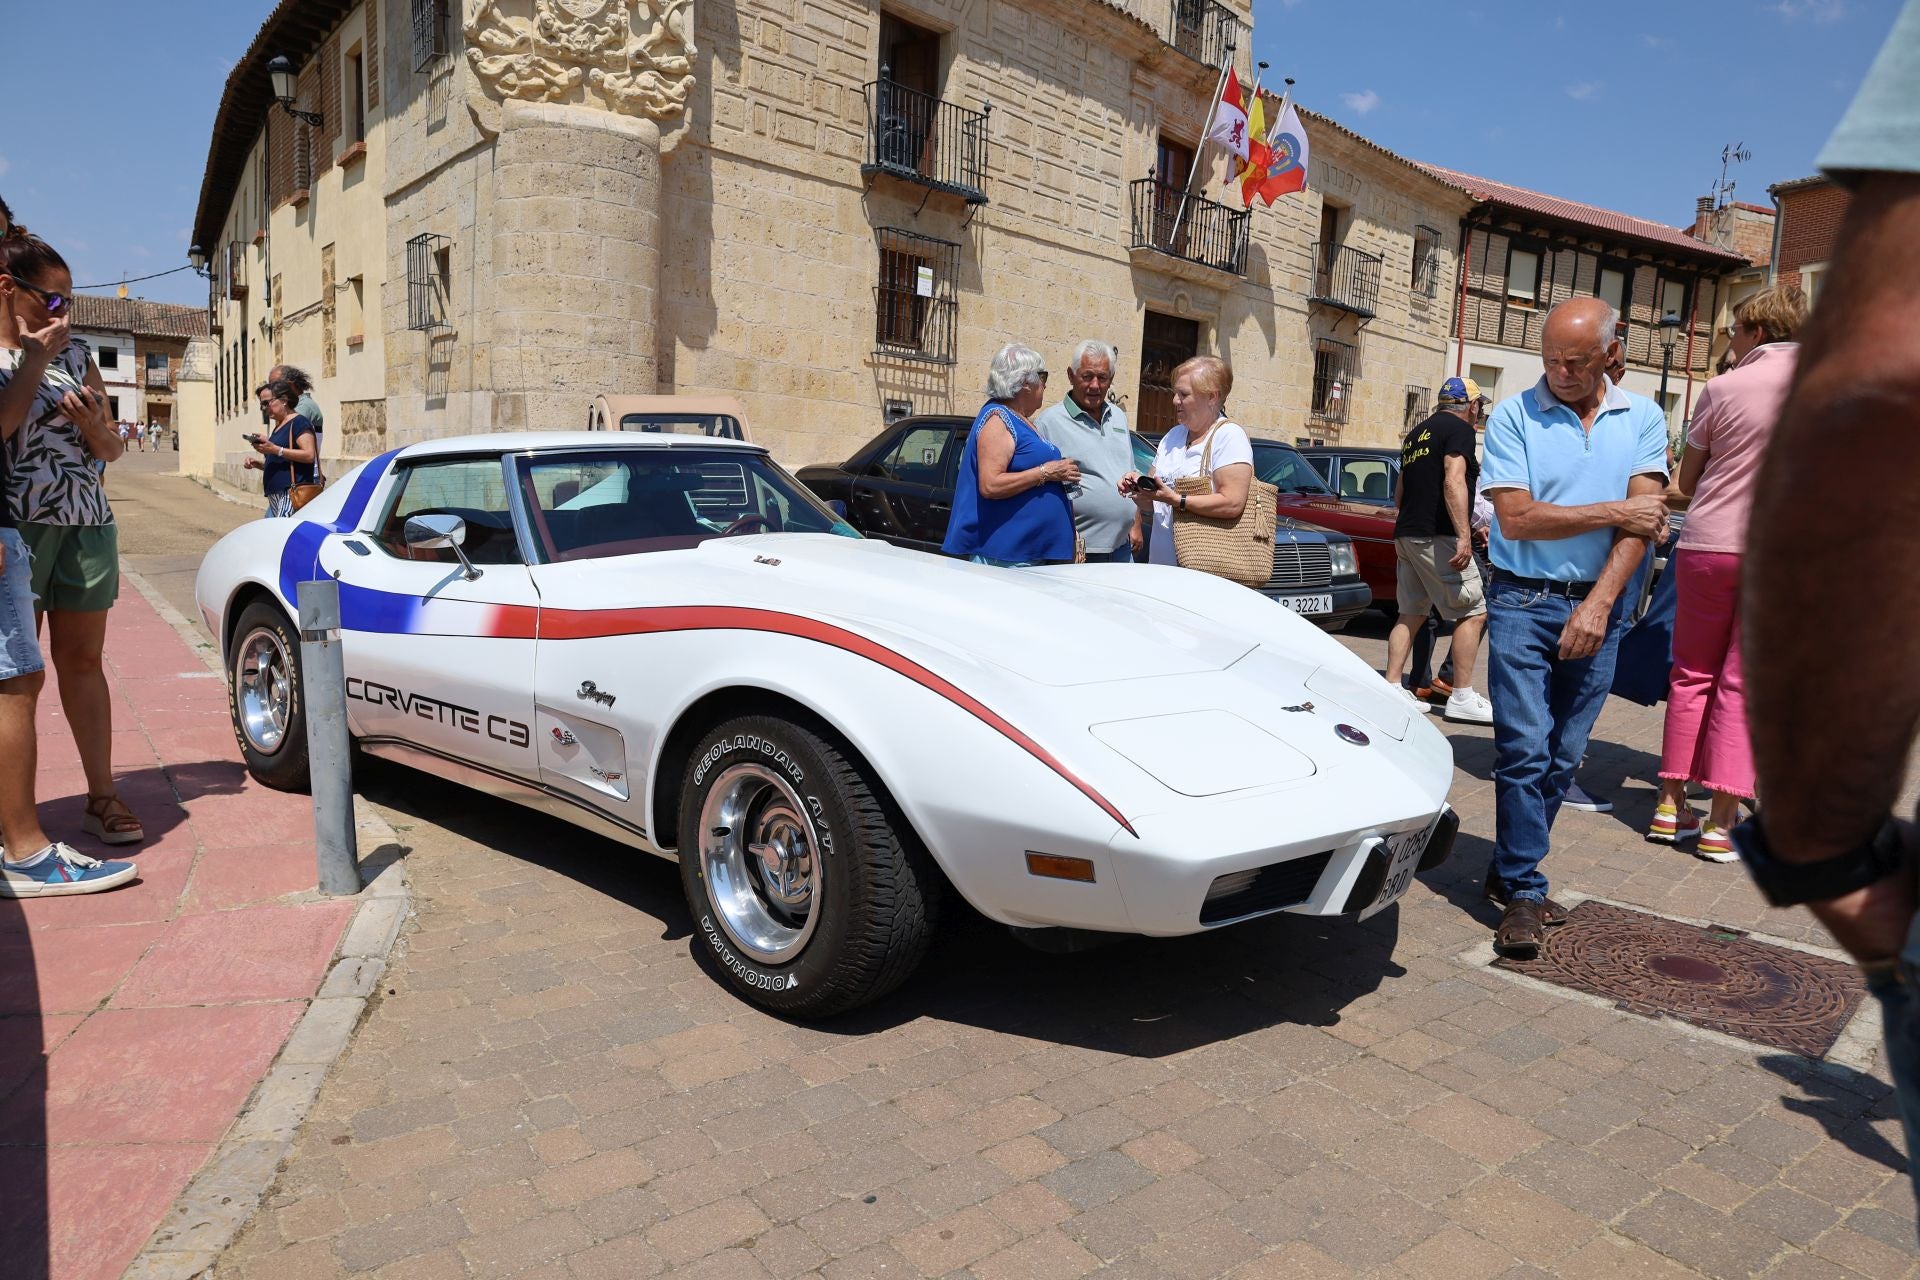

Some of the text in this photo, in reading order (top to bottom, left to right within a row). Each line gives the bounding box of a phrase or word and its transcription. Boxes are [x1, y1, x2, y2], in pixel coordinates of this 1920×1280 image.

[1295, 597, 1319, 613] 3222
[1323, 596, 1329, 611] K
[345, 677, 530, 748] CORVETTE C3
[693, 735, 835, 855] GEOLANDAR A/T
[701, 915, 799, 991] YOKOHAMA
